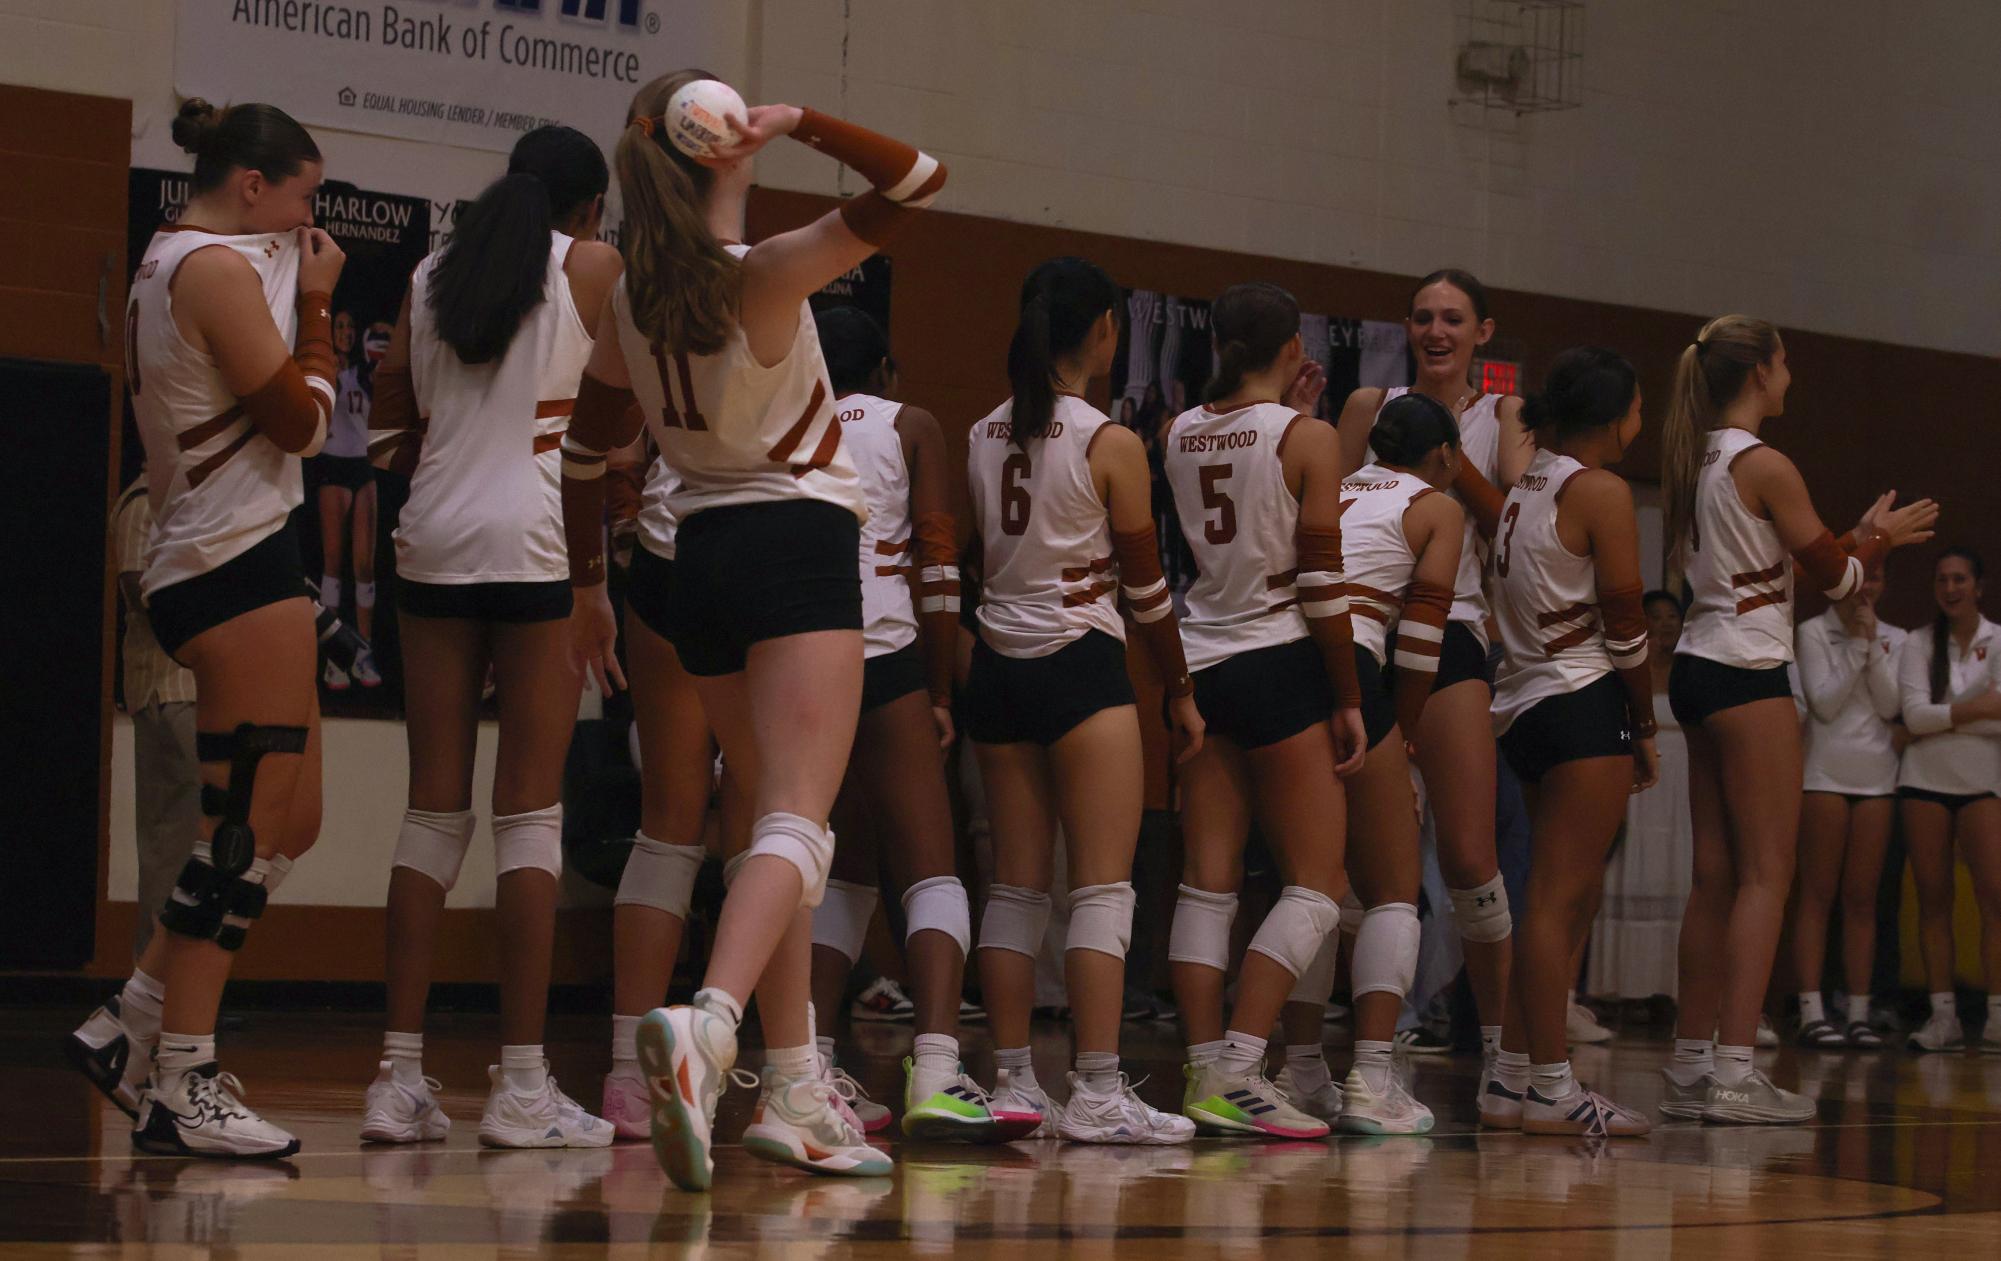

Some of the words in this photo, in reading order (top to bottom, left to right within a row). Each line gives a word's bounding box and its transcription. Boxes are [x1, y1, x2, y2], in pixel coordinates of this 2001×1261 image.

[232, 0, 371, 42] American
[383, 6, 451, 54] Bank
[462, 21, 490, 60] of
[500, 25, 639, 83] Commerce
[363, 92, 395, 112] EQUAL
[399, 97, 445, 120] HOUSING
[447, 105, 485, 125] LENDER
[494, 112, 536, 132] MEMBER
[315, 193, 412, 227] HARLOW
[325, 221, 401, 243] HERNANDEZ
[1180, 430, 1257, 453] WESTWOOD
[1001, 453, 1031, 536] 6
[1199, 463, 1236, 545] 5
